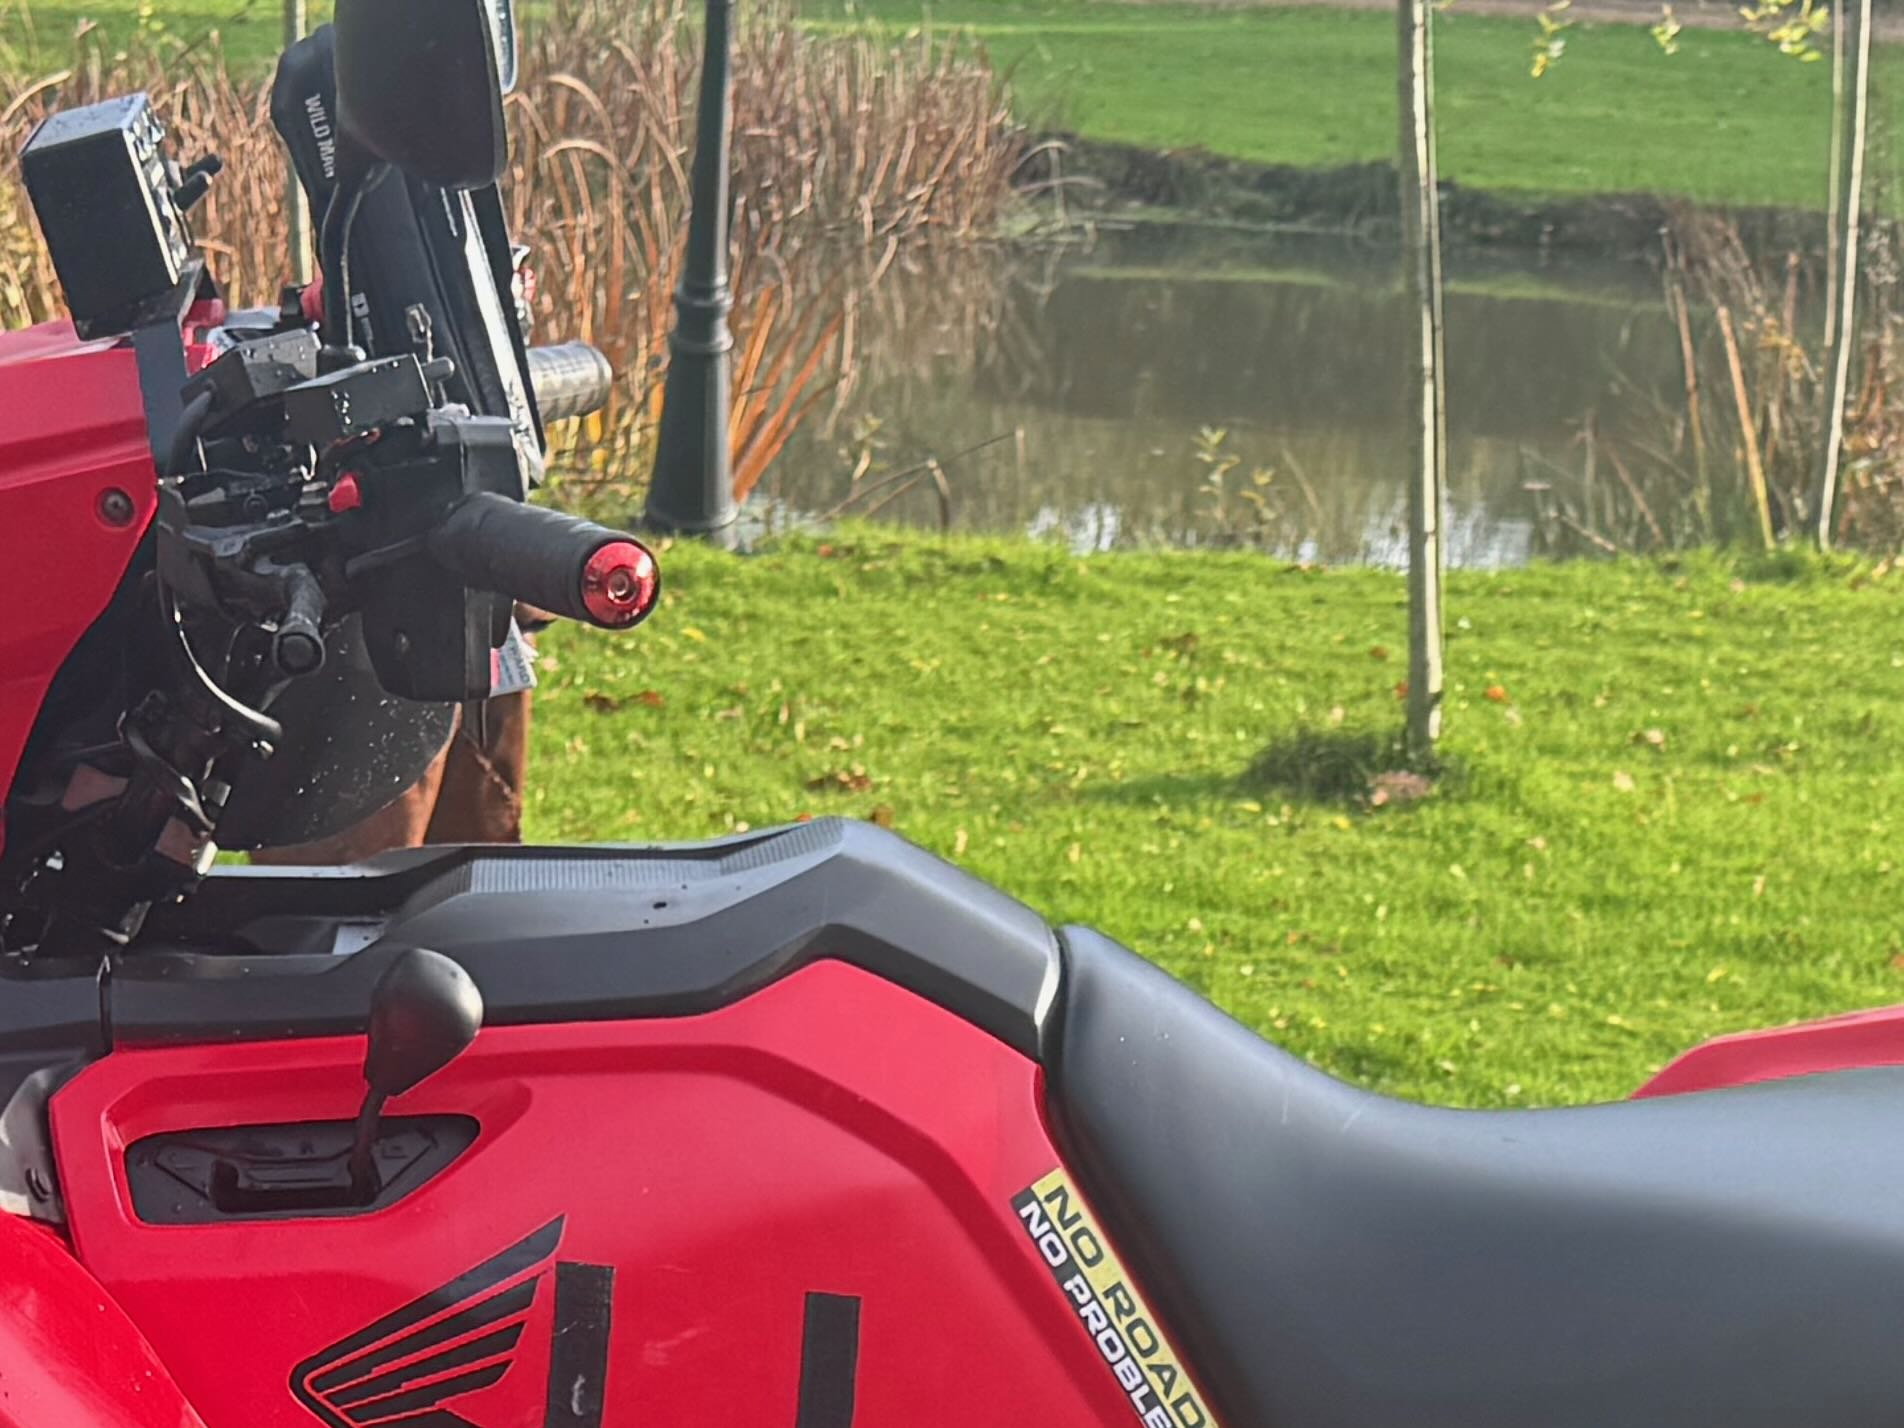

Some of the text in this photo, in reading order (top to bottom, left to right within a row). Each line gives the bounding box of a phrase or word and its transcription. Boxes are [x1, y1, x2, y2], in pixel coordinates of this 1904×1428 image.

[304, 92, 331, 139] WILD
[1019, 1200, 1068, 1267] NO
[1044, 1184, 1104, 1269] NO
